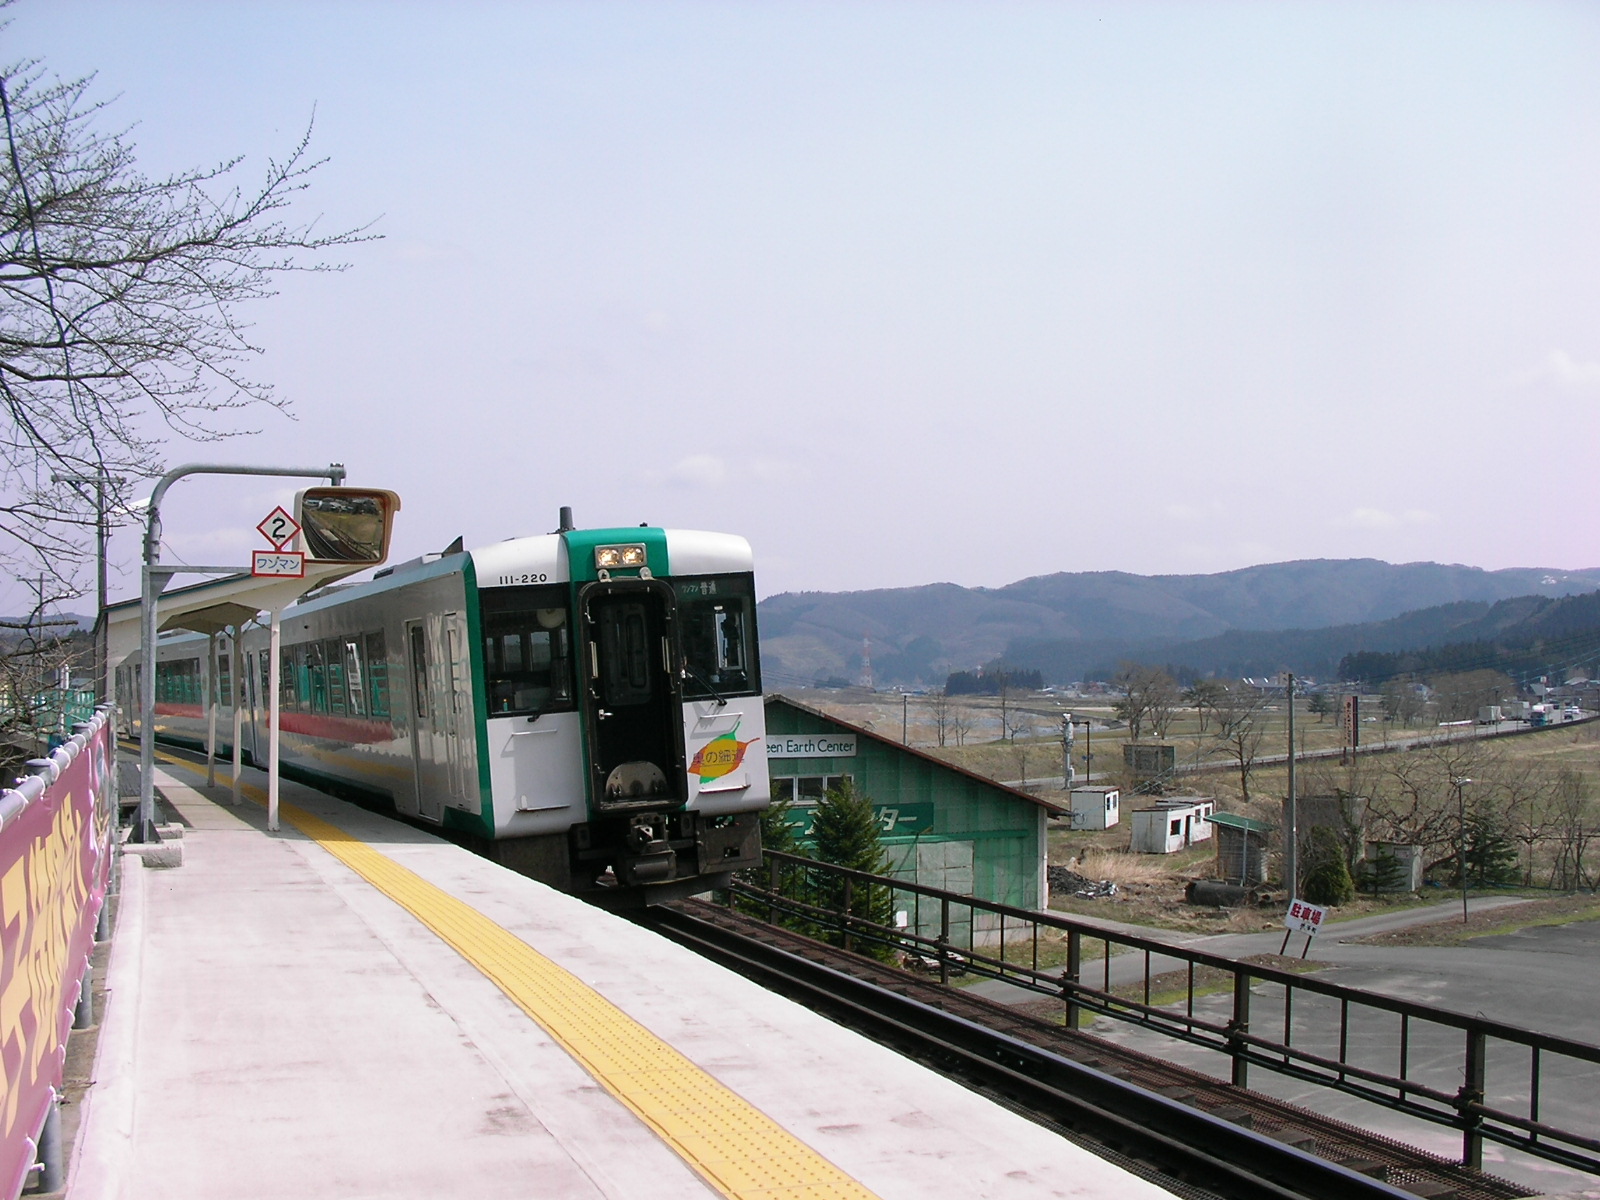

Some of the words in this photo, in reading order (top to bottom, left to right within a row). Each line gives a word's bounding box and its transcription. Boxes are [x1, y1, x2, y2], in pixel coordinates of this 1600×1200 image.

[272, 517, 286, 538] 2
[257, 558, 300, 570] ワンマン
[499, 573, 547, 585] 111-220
[786, 739, 815, 752] Earth
[817, 739, 854, 752] Center
[1290, 902, 1323, 926] 駐車場
